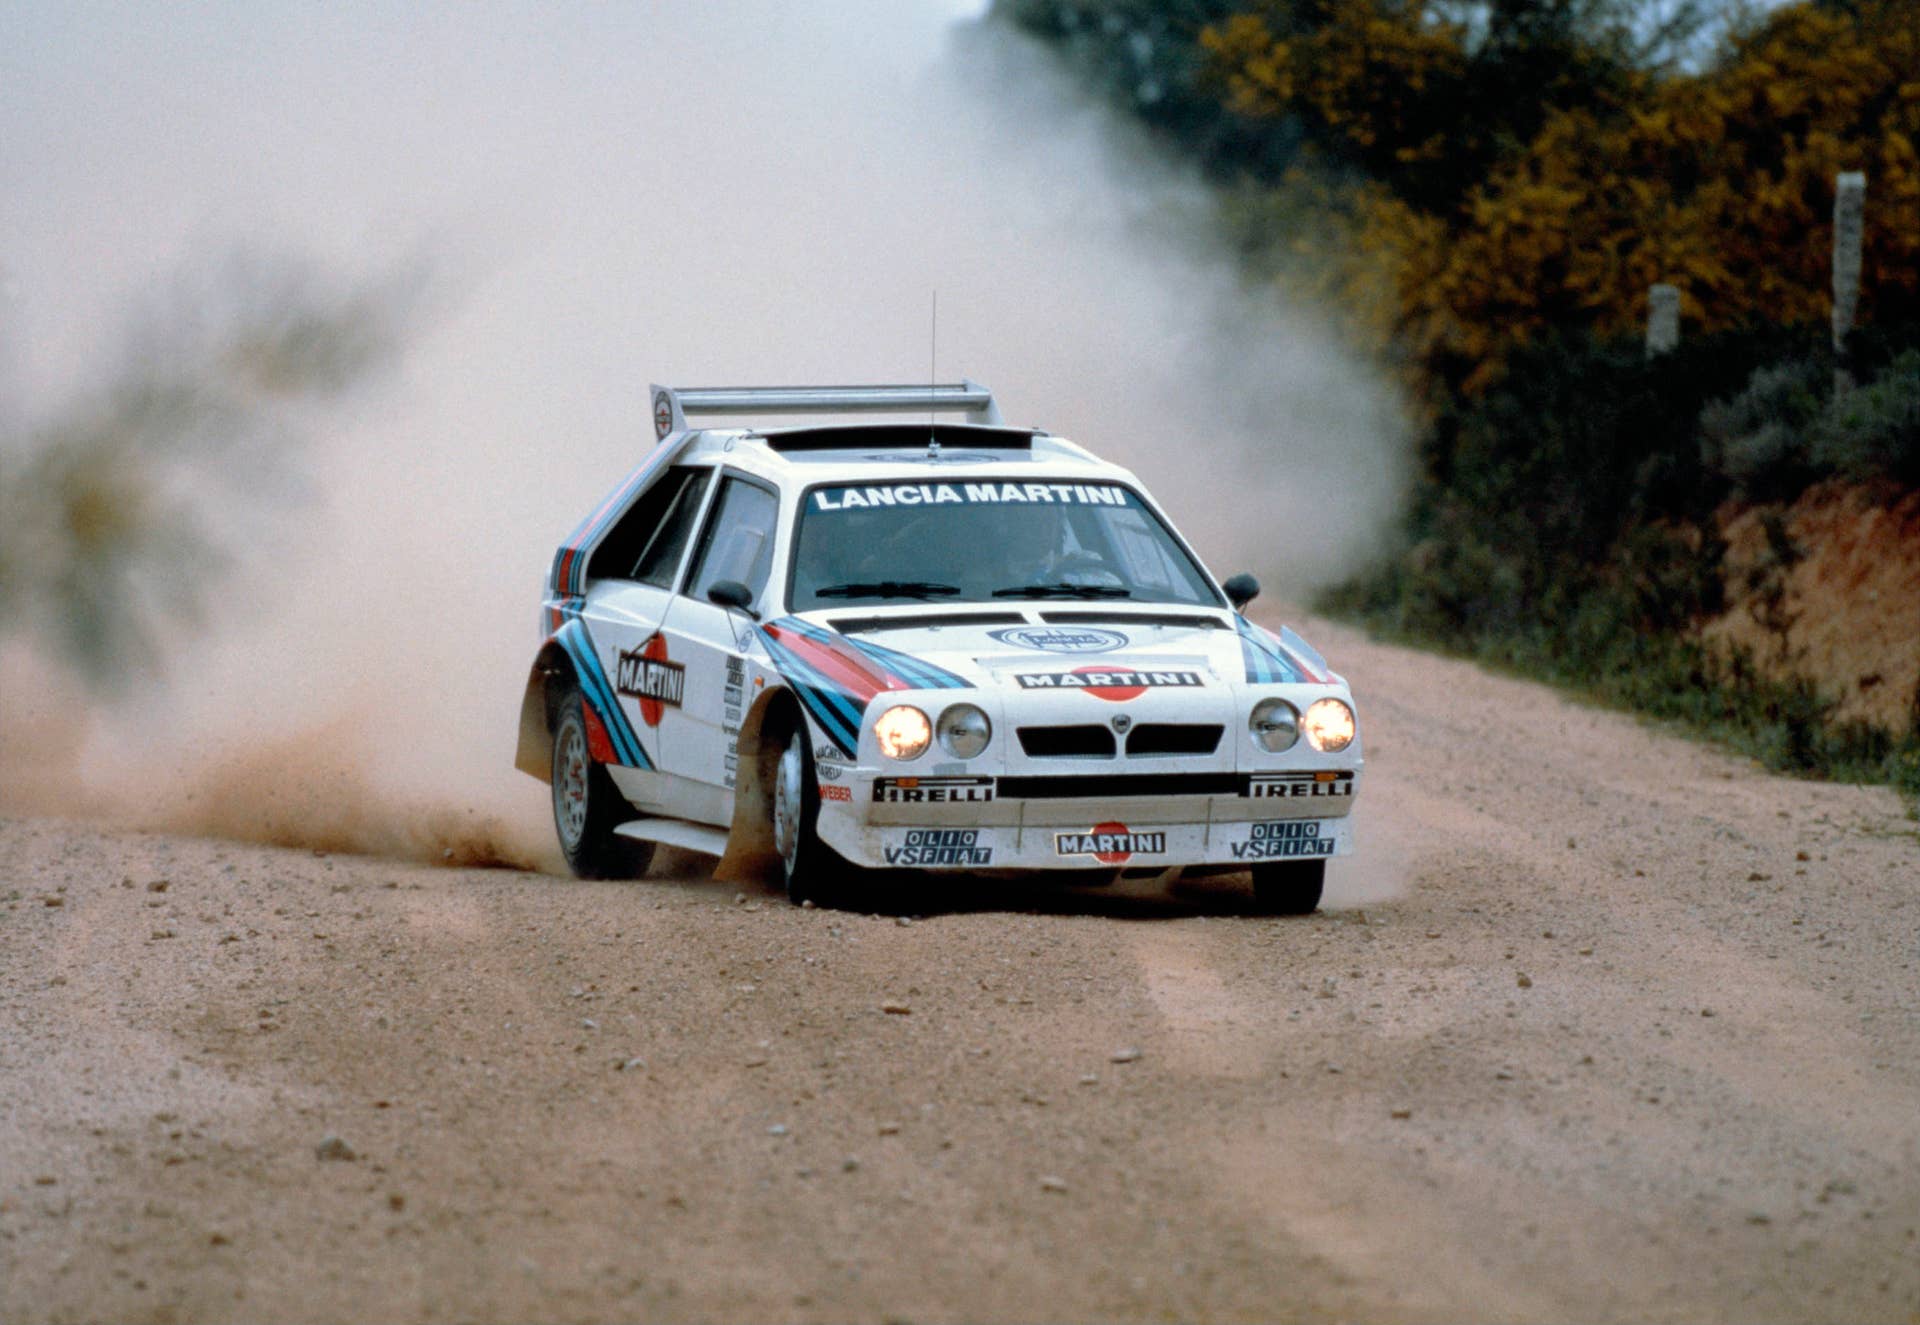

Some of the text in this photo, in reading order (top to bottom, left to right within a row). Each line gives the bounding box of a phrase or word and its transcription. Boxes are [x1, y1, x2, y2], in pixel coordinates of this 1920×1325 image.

[814, 483, 1127, 510] LANCIA MARTINI
[620, 658, 683, 702] MARTINI
[1021, 672, 1195, 687] MARTINI
[819, 784, 853, 802] WEBER
[905, 831, 978, 847] OLIO
[1251, 823, 1319, 840] OLIO
[1061, 834, 1162, 853] MARTINI
